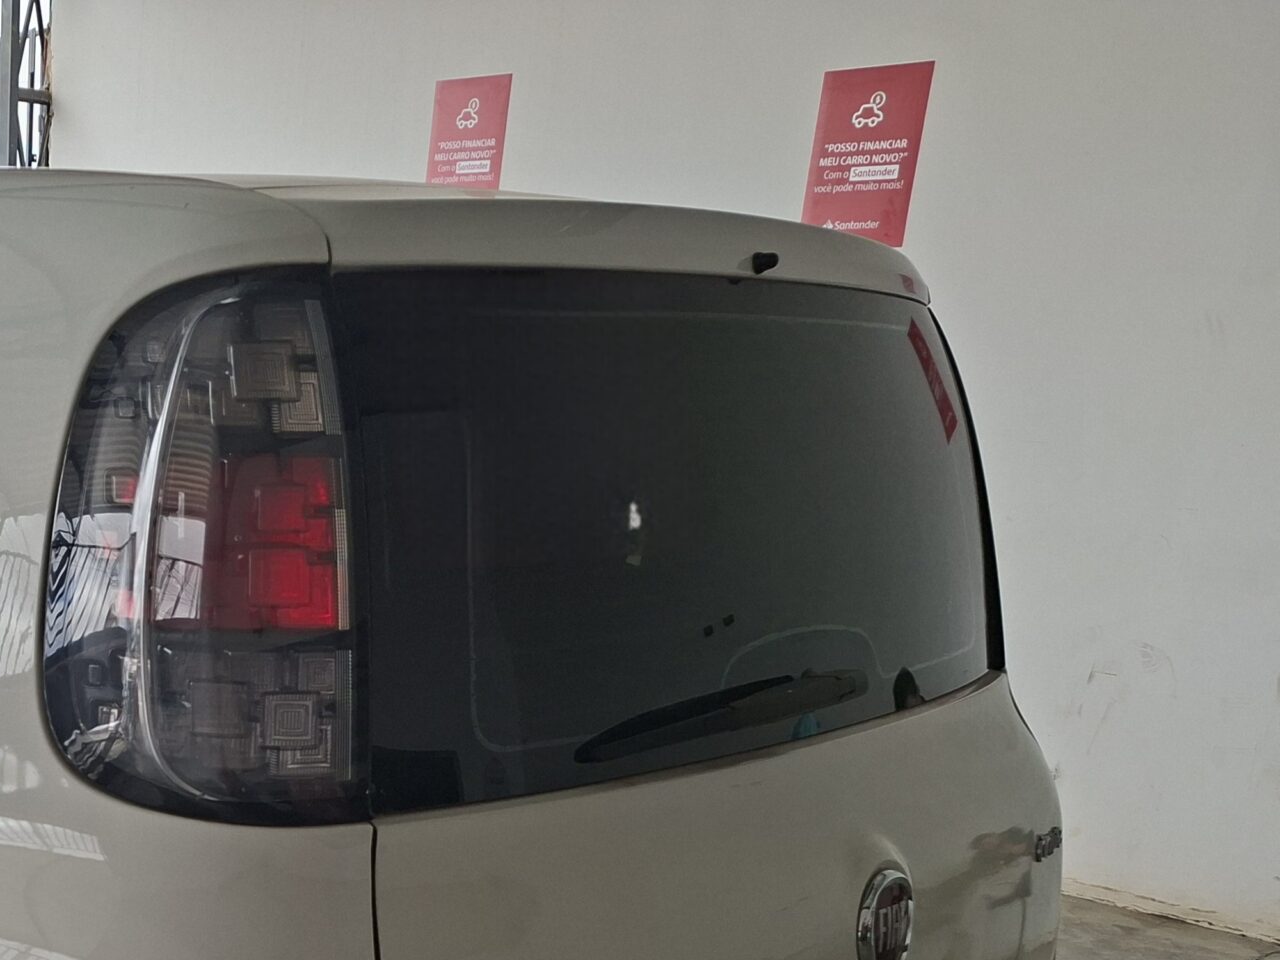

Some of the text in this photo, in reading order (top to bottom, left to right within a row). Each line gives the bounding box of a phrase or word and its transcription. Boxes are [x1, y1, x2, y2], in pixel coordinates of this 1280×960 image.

[461, 138, 496, 149] FINANCIAR
[859, 139, 908, 151] FINANCIAR
[434, 152, 449, 161] MEU
[449, 151, 470, 160] CARRO
[819, 156, 839, 167] MEU
[840, 154, 870, 165] CARRO
[437, 164, 451, 173] Com
[457, 161, 489, 171] Santander
[824, 166, 898, 180] Com o Santander
[814, 179, 904, 195] você pode muito mais!
[834, 219, 880, 231] Santander
[879, 896, 908, 954] FIAT
